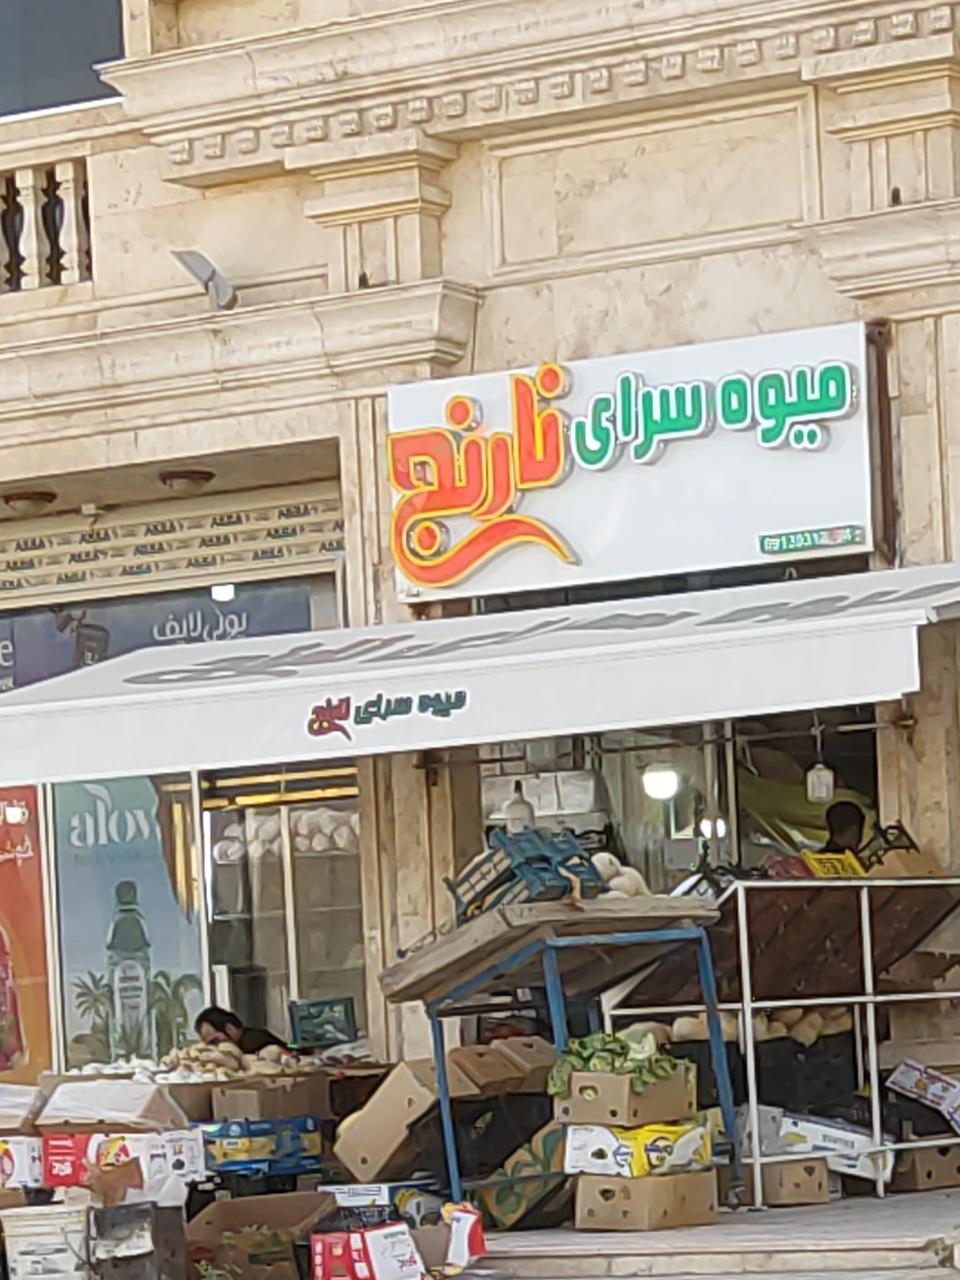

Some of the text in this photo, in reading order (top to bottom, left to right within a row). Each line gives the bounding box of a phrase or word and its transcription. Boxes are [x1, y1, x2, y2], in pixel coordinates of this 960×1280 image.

[387, 362, 851, 588] میوه سرای نارنج
[354, 692, 413, 725] سرای
[417, 689, 467, 718] میوه
